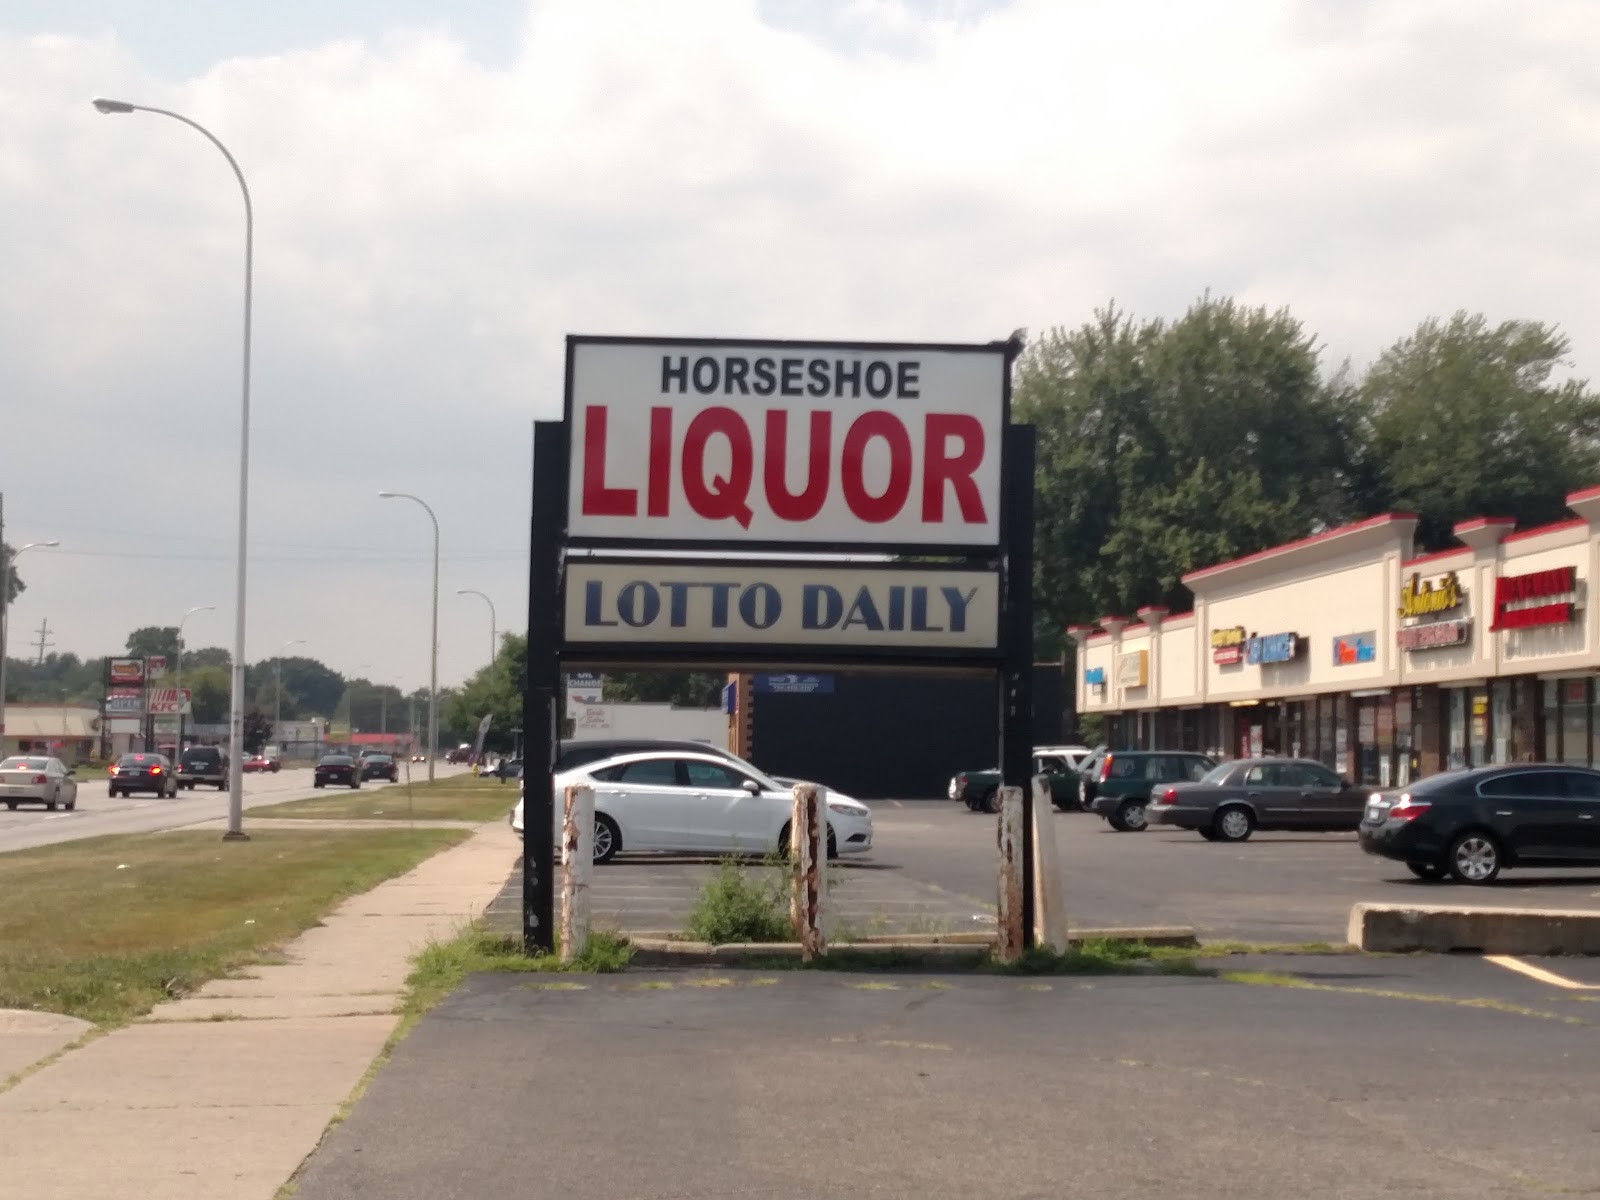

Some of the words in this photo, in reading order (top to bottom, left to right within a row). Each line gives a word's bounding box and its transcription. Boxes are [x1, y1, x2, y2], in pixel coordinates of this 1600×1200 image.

[661, 356, 921, 399] HORSESHOE
[582, 405, 987, 531] LIQUOR
[584, 580, 783, 630] LOTTO
[801, 584, 979, 633] DAILY
[150, 702, 179, 712] KFC
